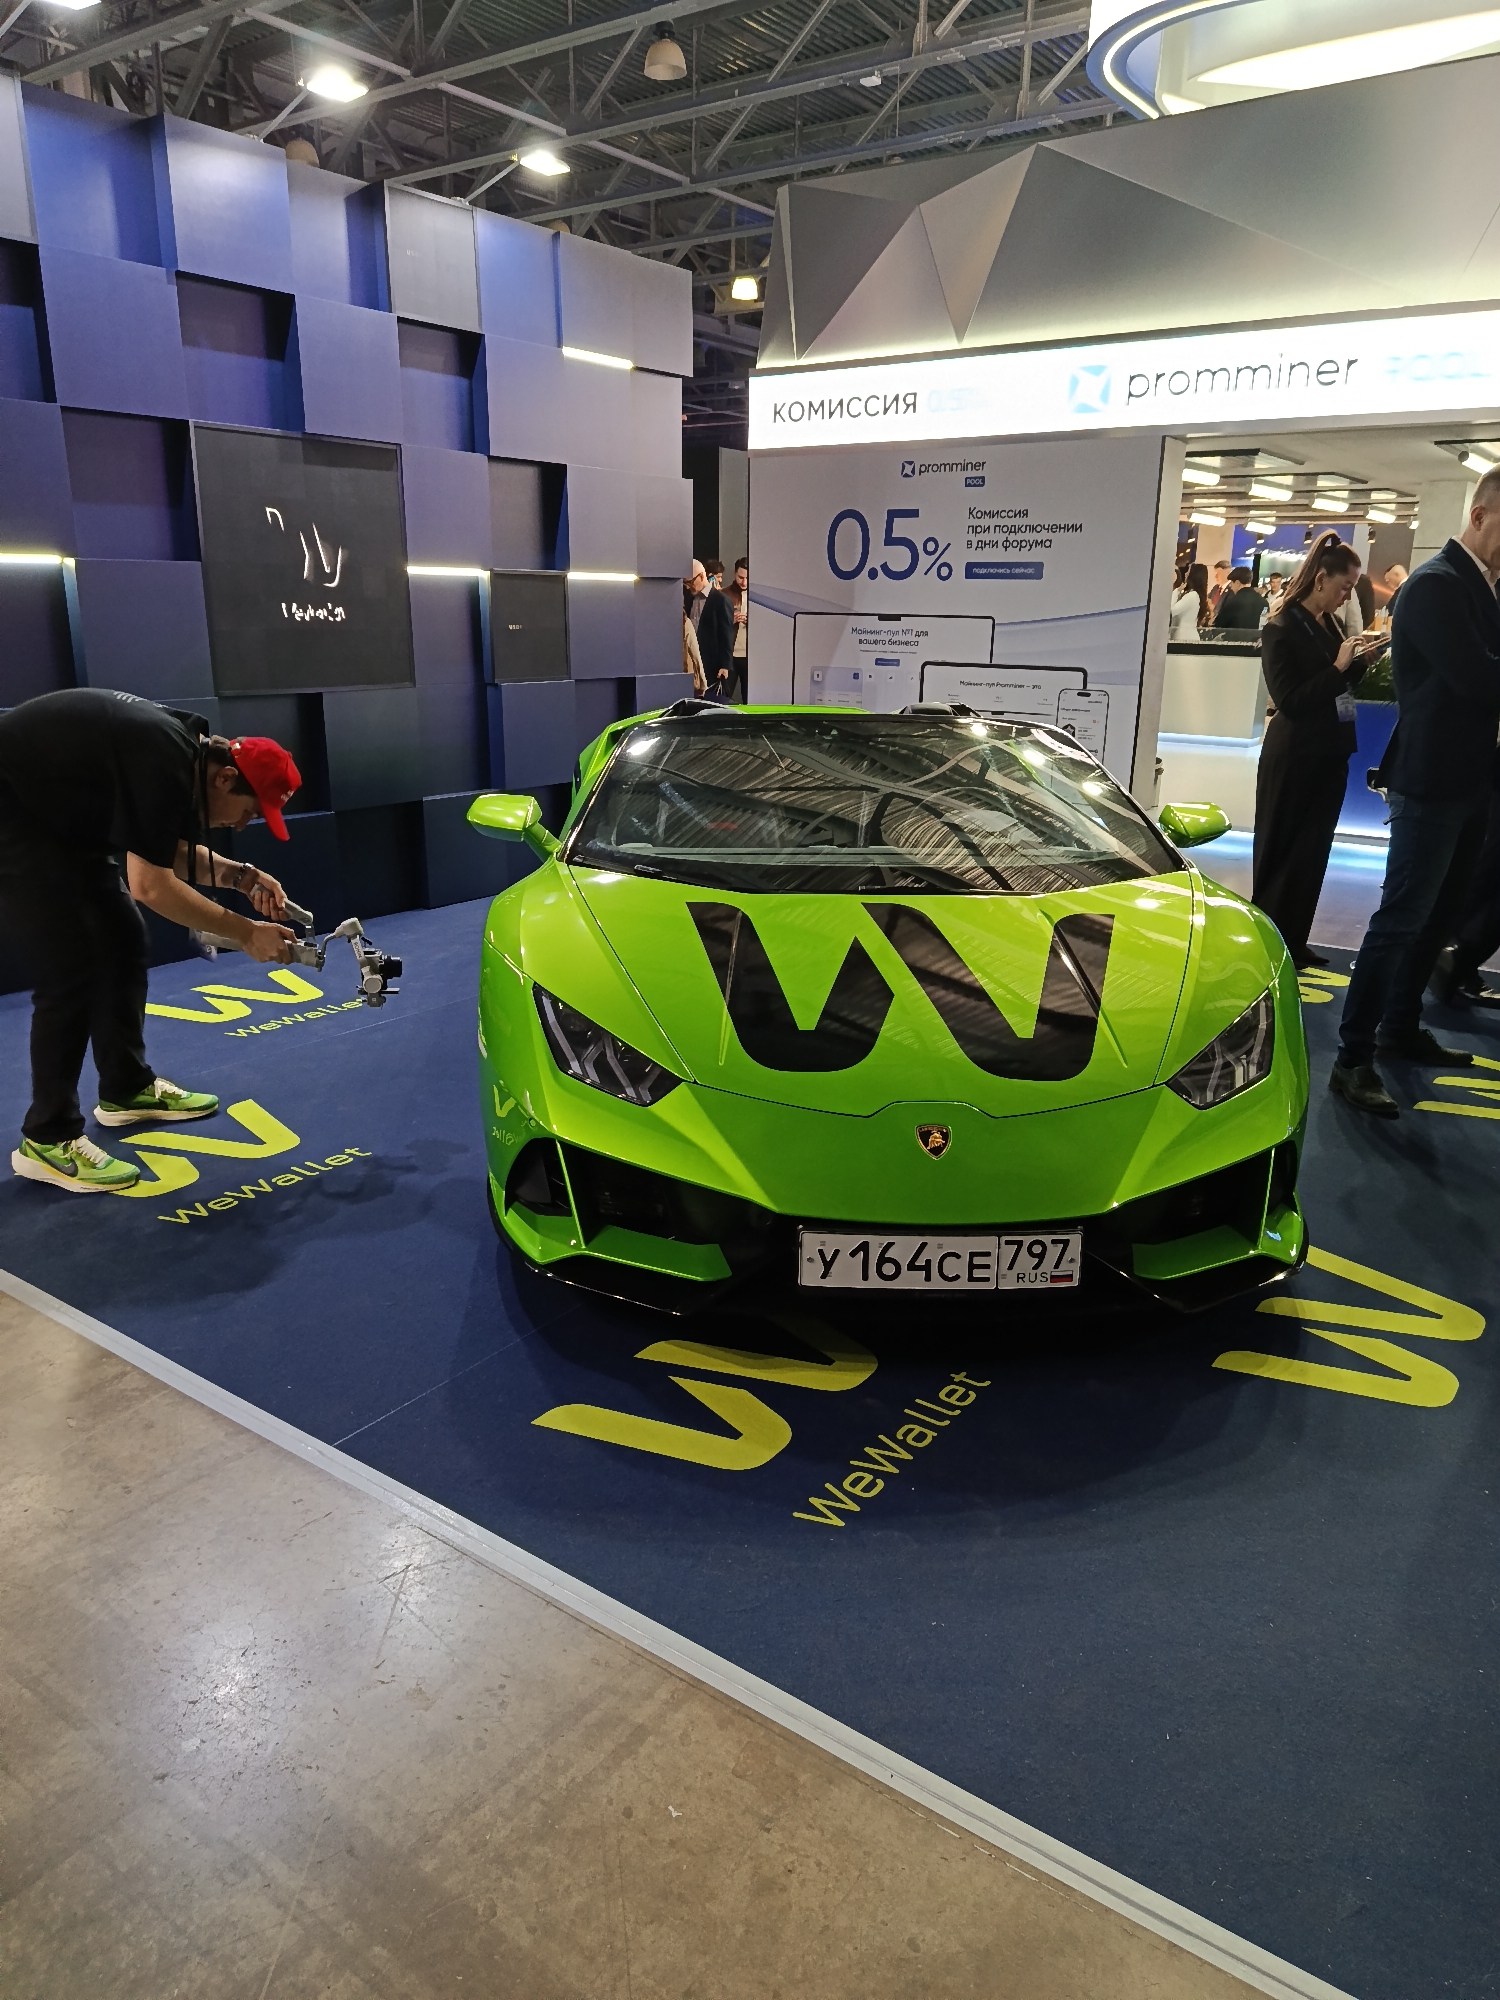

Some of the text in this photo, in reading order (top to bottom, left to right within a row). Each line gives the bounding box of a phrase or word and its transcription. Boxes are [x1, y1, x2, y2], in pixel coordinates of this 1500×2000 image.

[1126, 353, 1358, 405] promminer
[773, 392, 917, 423] КОМИССИЯ
[918, 459, 986, 476] promminer
[968, 506, 1029, 520] Комиссия
[826, 508, 953, 581] 0.5%
[966, 522, 1083, 536] при подключении
[966, 537, 1053, 552] в дни форума
[157, 1147, 373, 1224] WeWallet
[1004, 1238, 1071, 1272] 797
[1016, 1272, 1049, 1283] RUS
[792, 1371, 992, 1527] WeWallet
